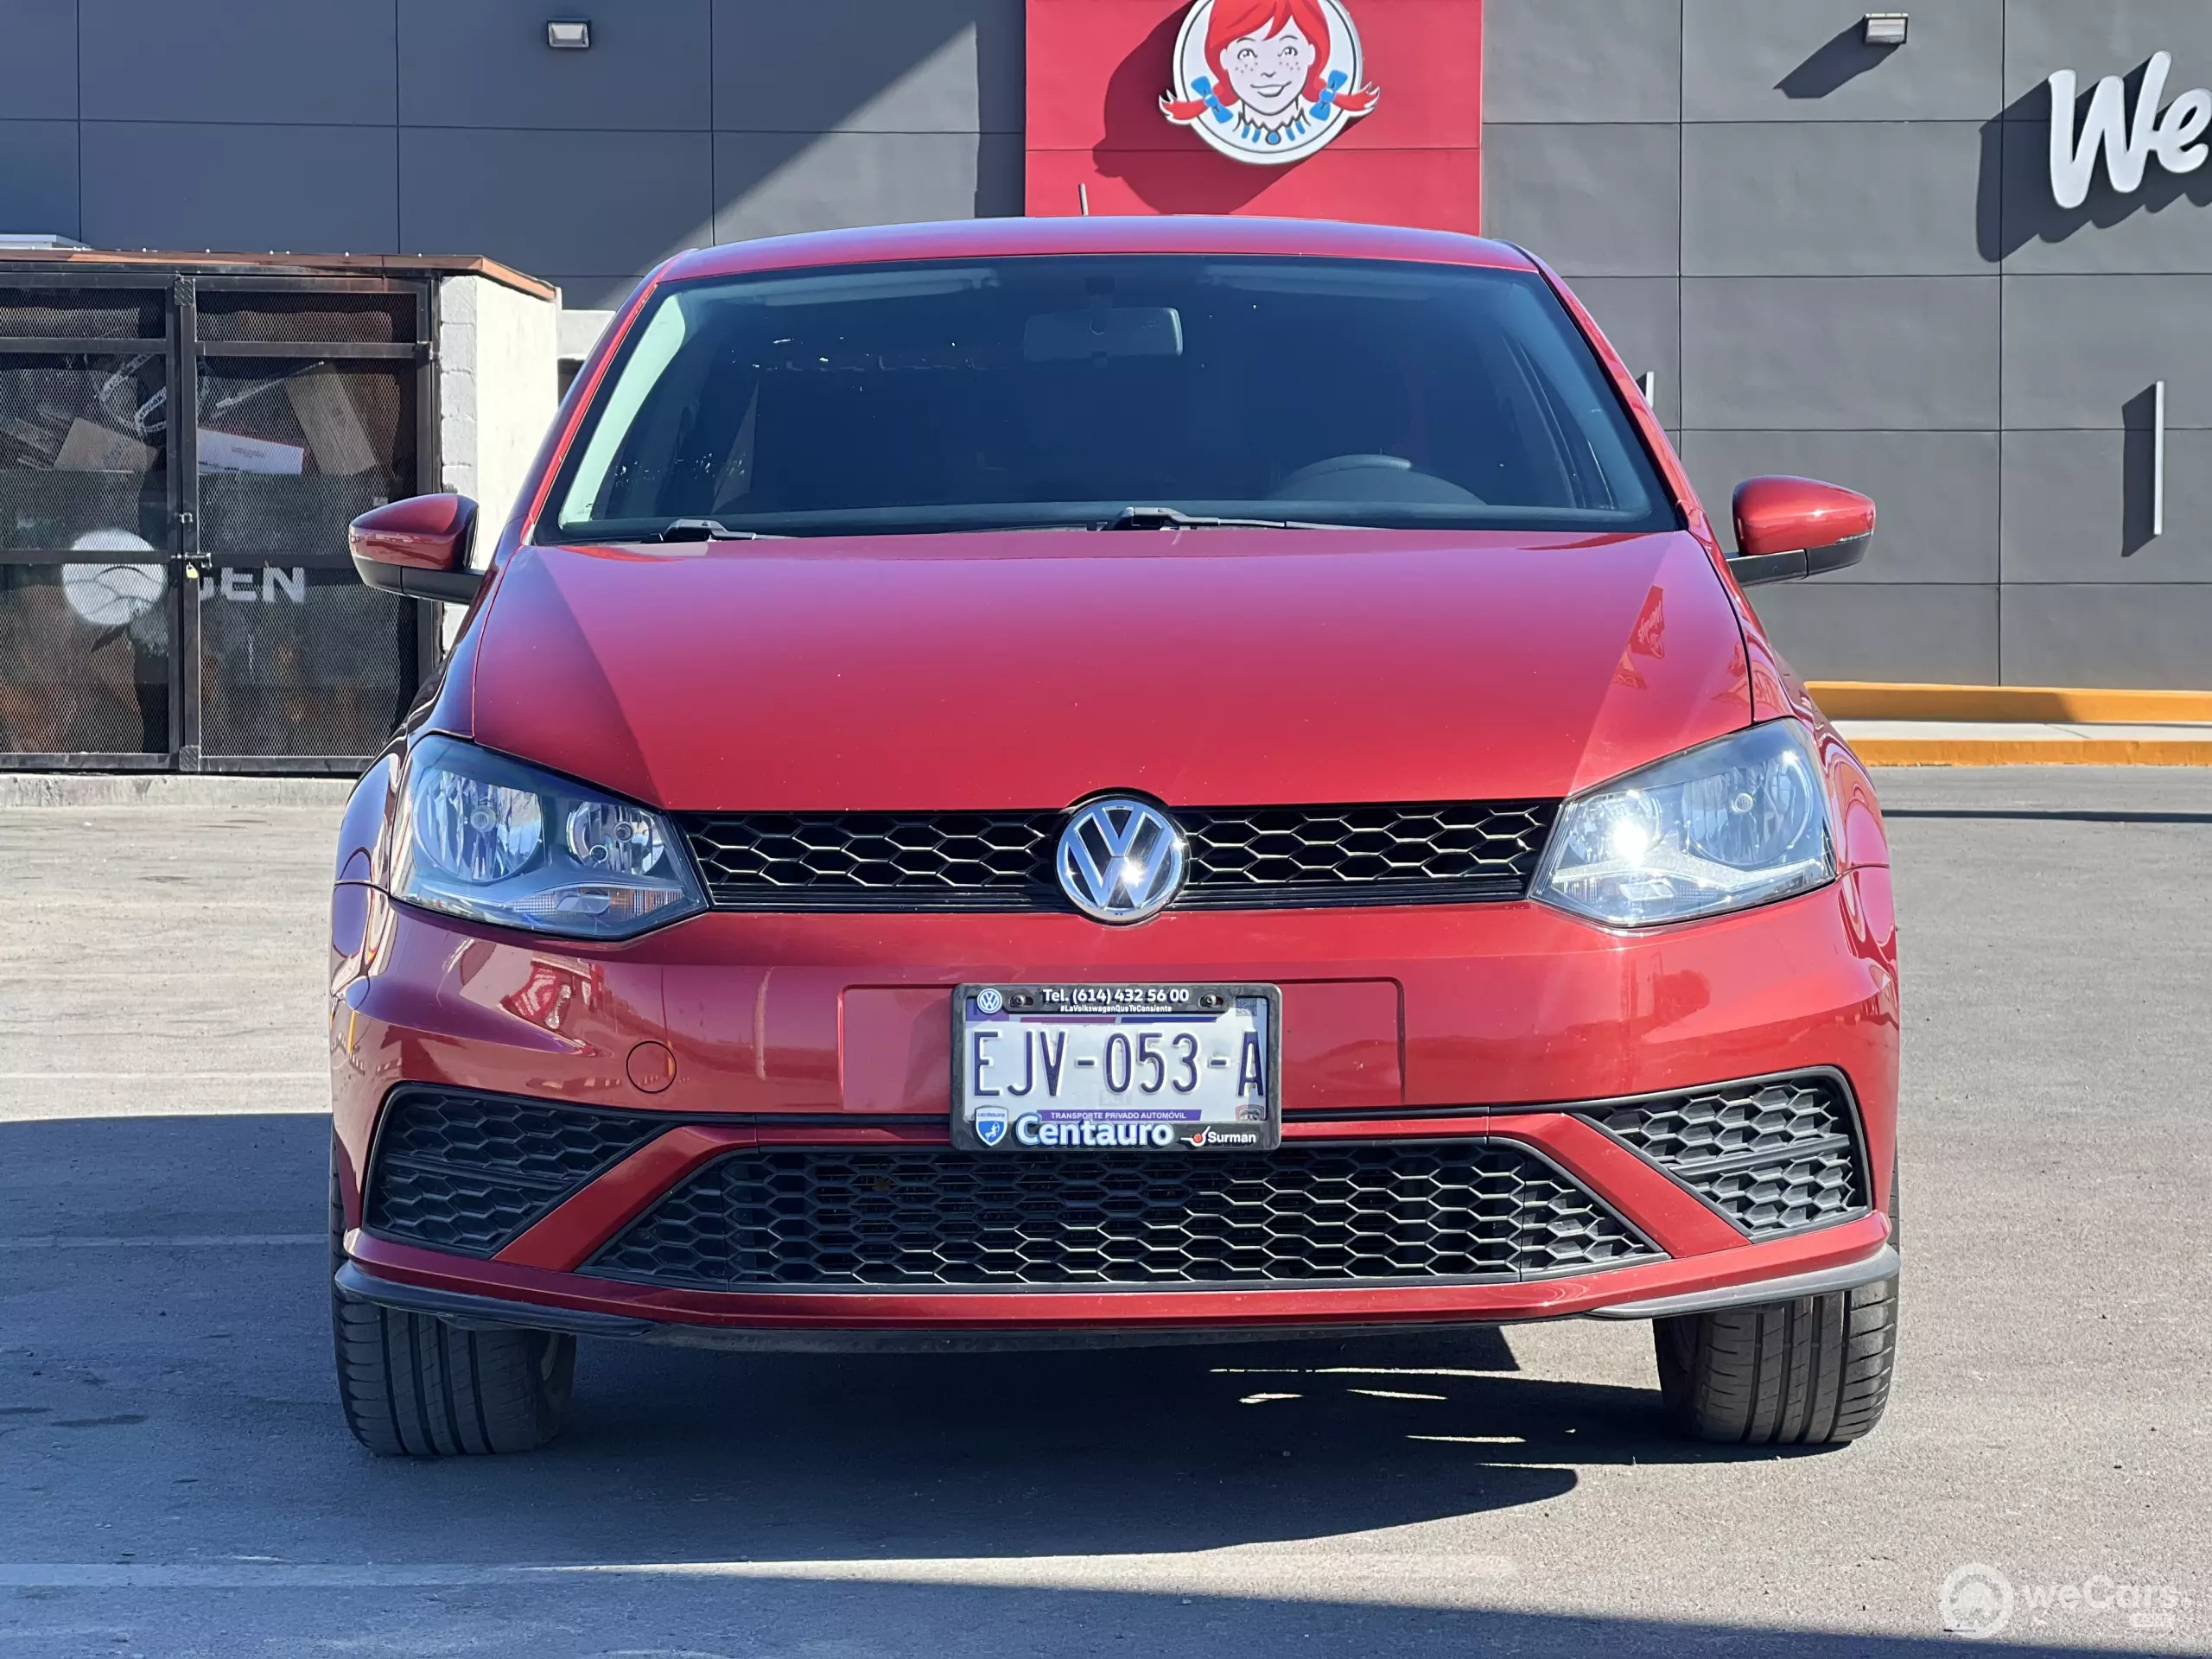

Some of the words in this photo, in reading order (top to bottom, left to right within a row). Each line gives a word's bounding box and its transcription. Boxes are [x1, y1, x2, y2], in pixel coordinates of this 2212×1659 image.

[2049, 50, 2212, 208] We
[1043, 988, 1069, 1002] Tel.
[1073, 988, 1111, 1004] (614)
[1115, 988, 1143, 1002] 432
[1147, 988, 1166, 1002] 56
[1169, 988, 1190, 1002] 00
[974, 1031, 1264, 1096] EJV-053-A
[1050, 1111, 1103, 1120] TRANSPORTE
[1104, 1111, 1140, 1120] PRIVADO
[1015, 1112, 1174, 1147] Centauro
[1207, 1131, 1256, 1143] Surman
